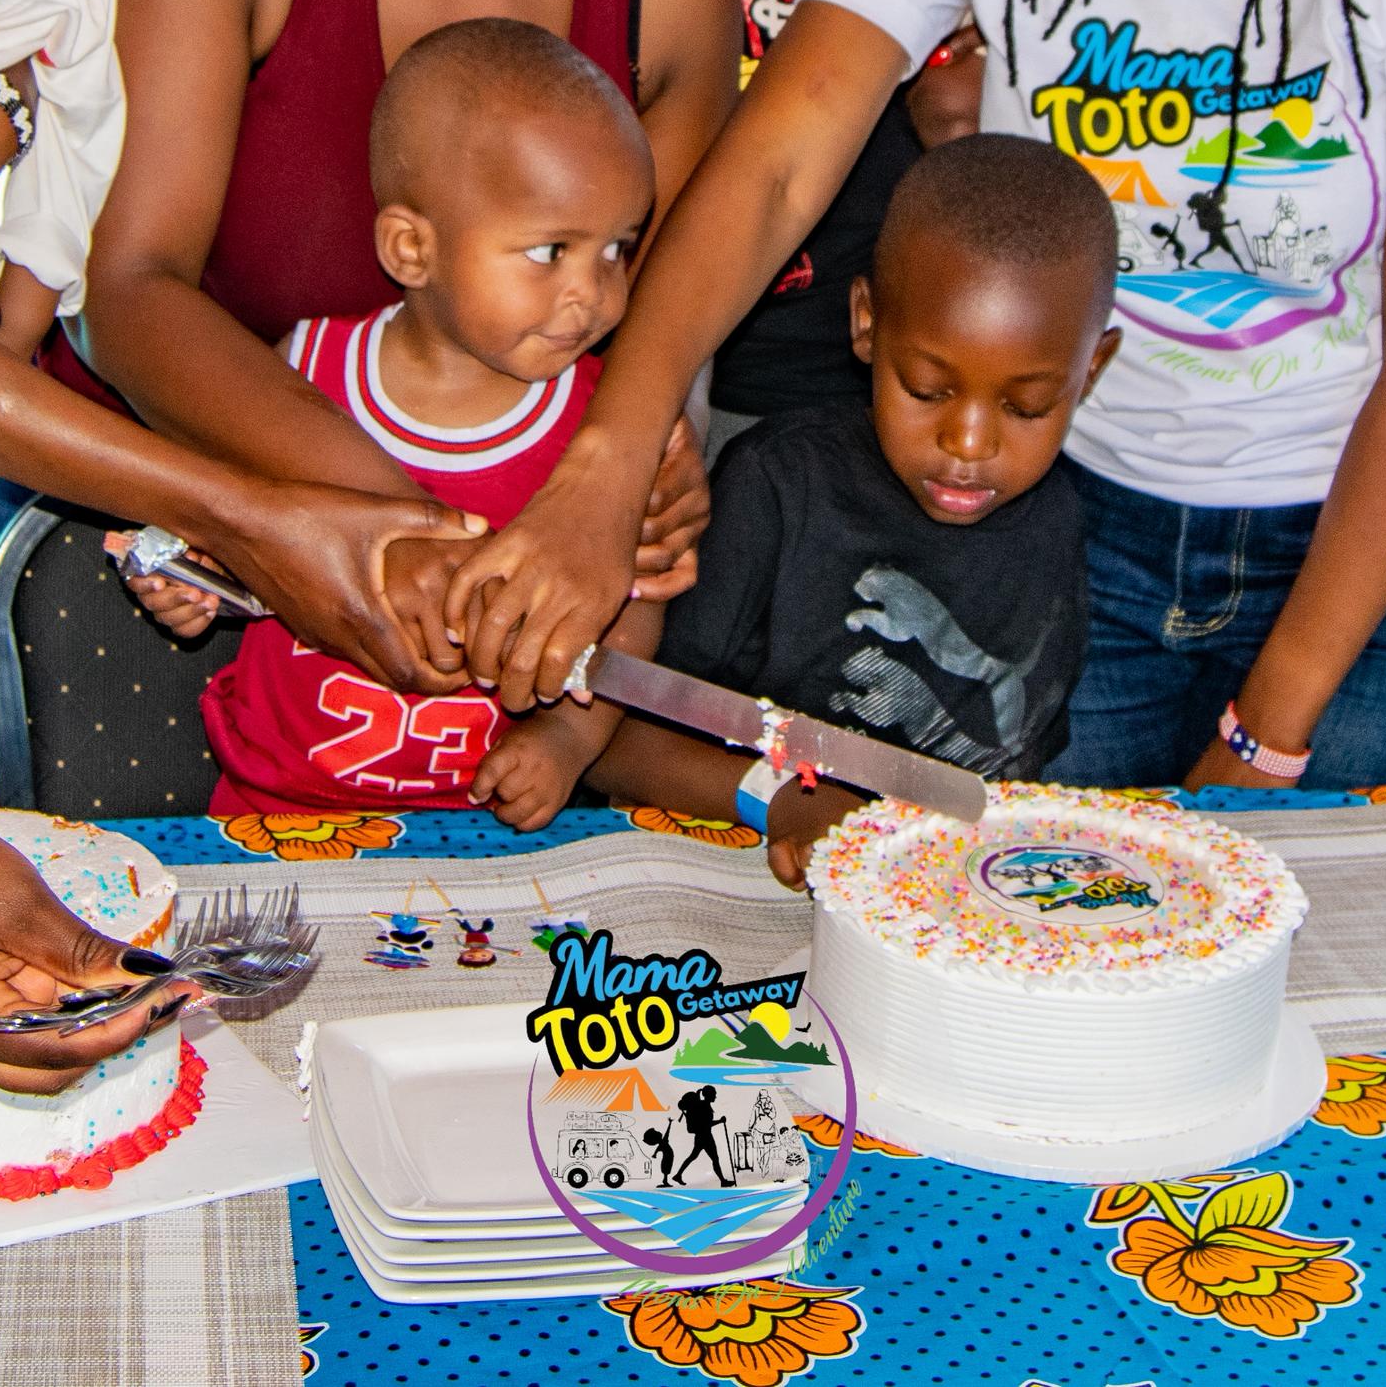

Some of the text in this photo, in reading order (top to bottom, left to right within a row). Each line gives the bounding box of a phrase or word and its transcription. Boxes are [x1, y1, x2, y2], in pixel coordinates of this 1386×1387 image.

[1061, 20, 1237, 92] Mama
[1192, 69, 1324, 114] Getaway
[1250, 350, 1301, 392] On
[307, 671, 499, 791] 23
